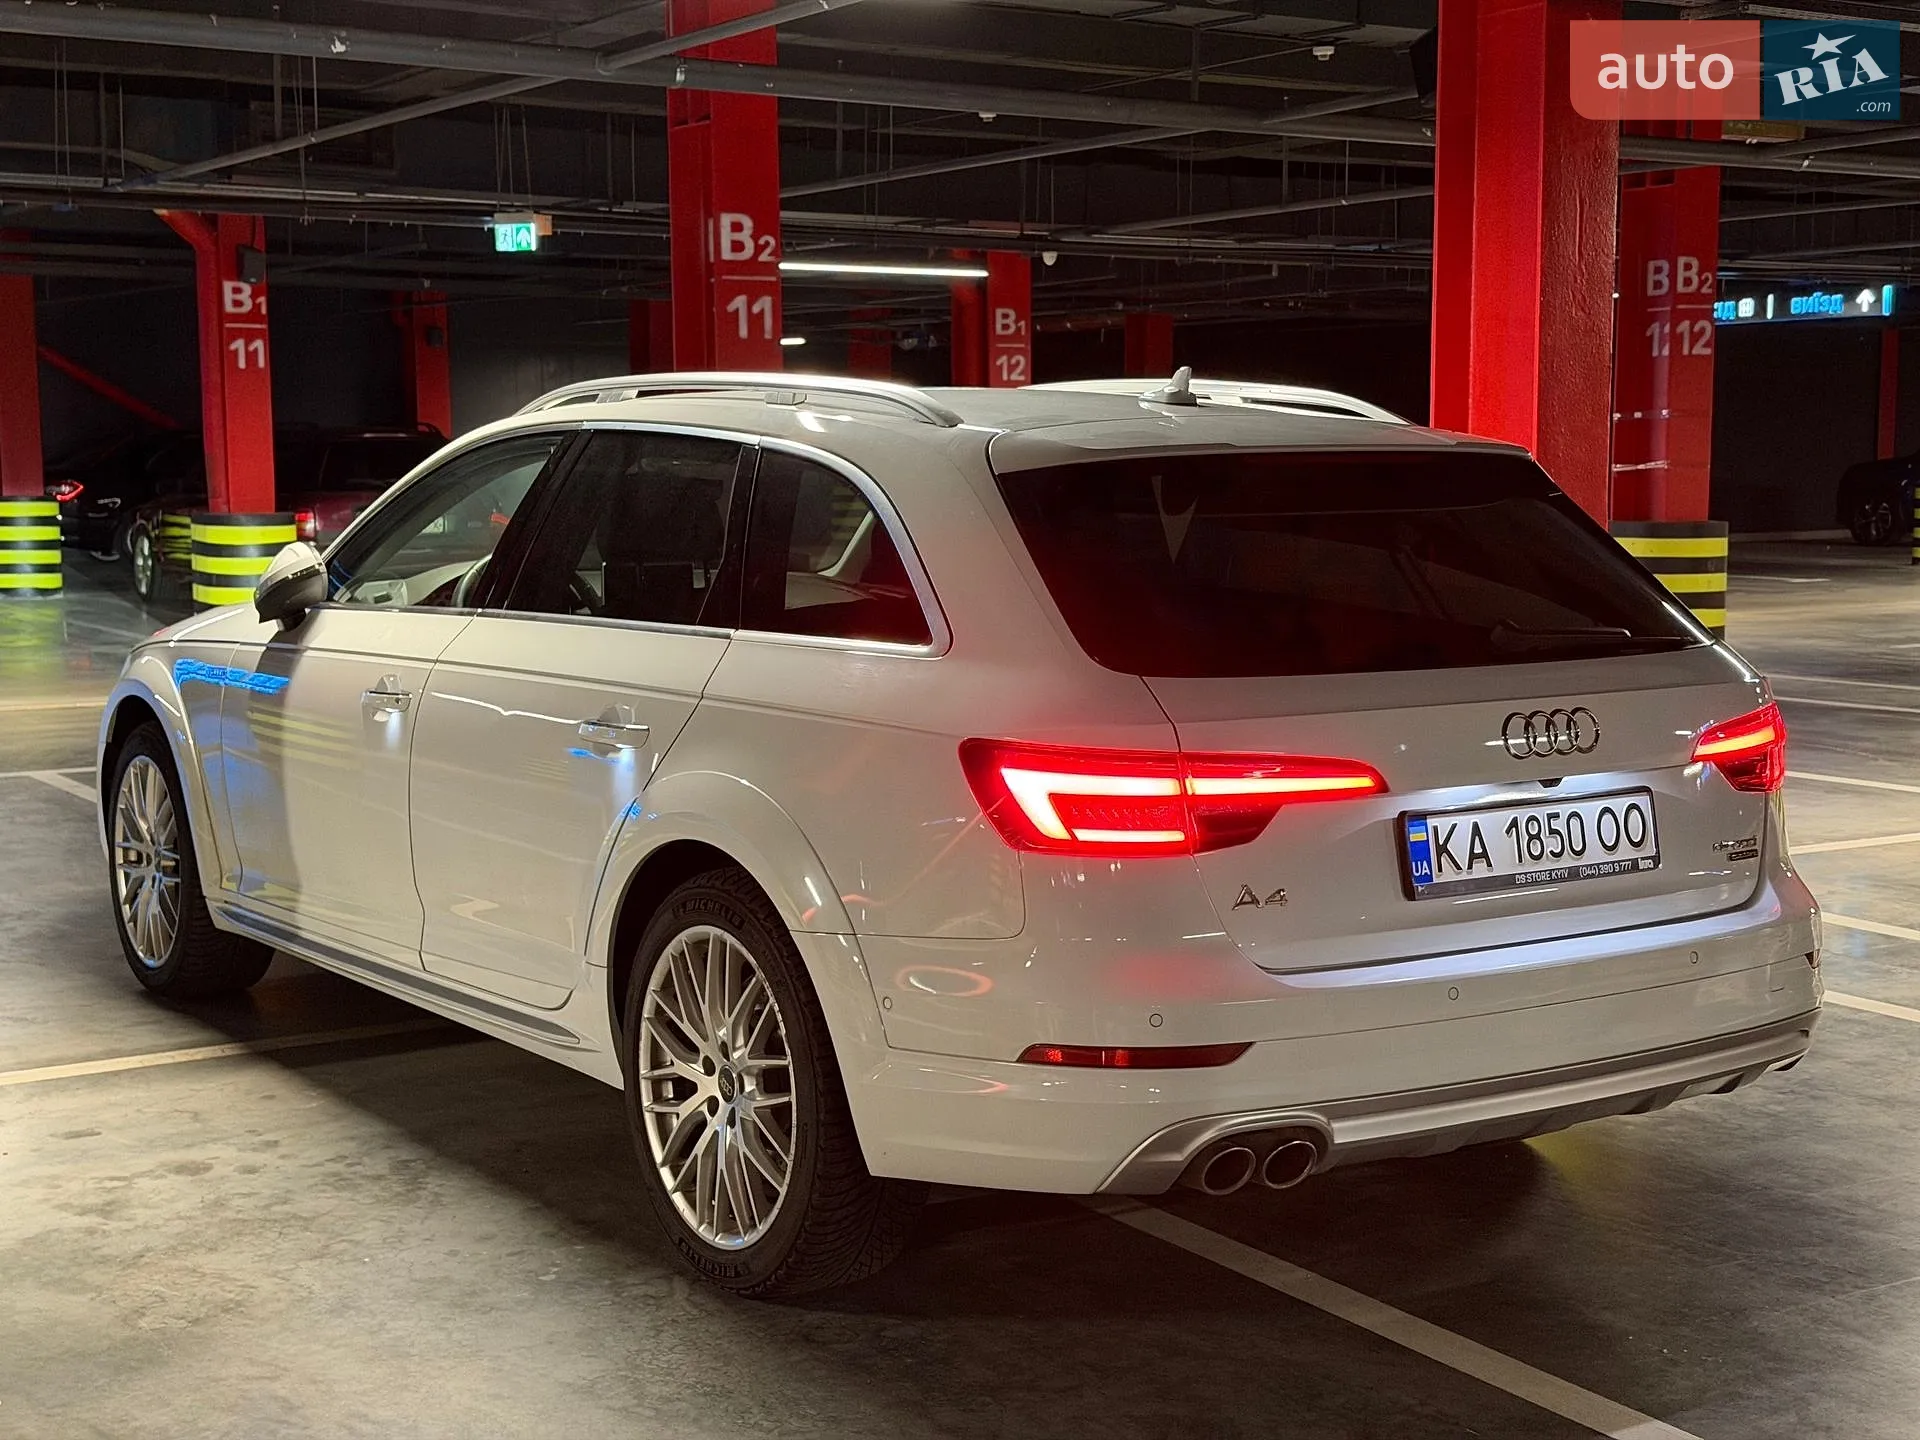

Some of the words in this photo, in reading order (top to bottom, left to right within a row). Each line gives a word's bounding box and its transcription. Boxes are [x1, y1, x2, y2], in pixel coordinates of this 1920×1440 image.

[719, 212, 777, 262] B2
[1676, 255, 1713, 294] B2
[222, 280, 267, 315] B1
[726, 294, 773, 340] 11
[994, 307, 1026, 336] B1
[228, 338, 266, 370] 11
[1675, 319, 1713, 356] 12
[995, 353, 1027, 381] 12
[1432, 820, 1493, 873] KA
[1505, 810, 1587, 864] 1850
[1596, 802, 1647, 852] OO
[1412, 859, 1431, 877] UA
[1526, 870, 1551, 883] STORE
[1551, 868, 1569, 880] KYIV
[1580, 865, 1599, 878] (044)
[1599, 863, 1614, 874] 390
[1614, 862, 1620, 873] 9
[1620, 861, 1632, 871] 777
[1231, 884, 1288, 910] A4
